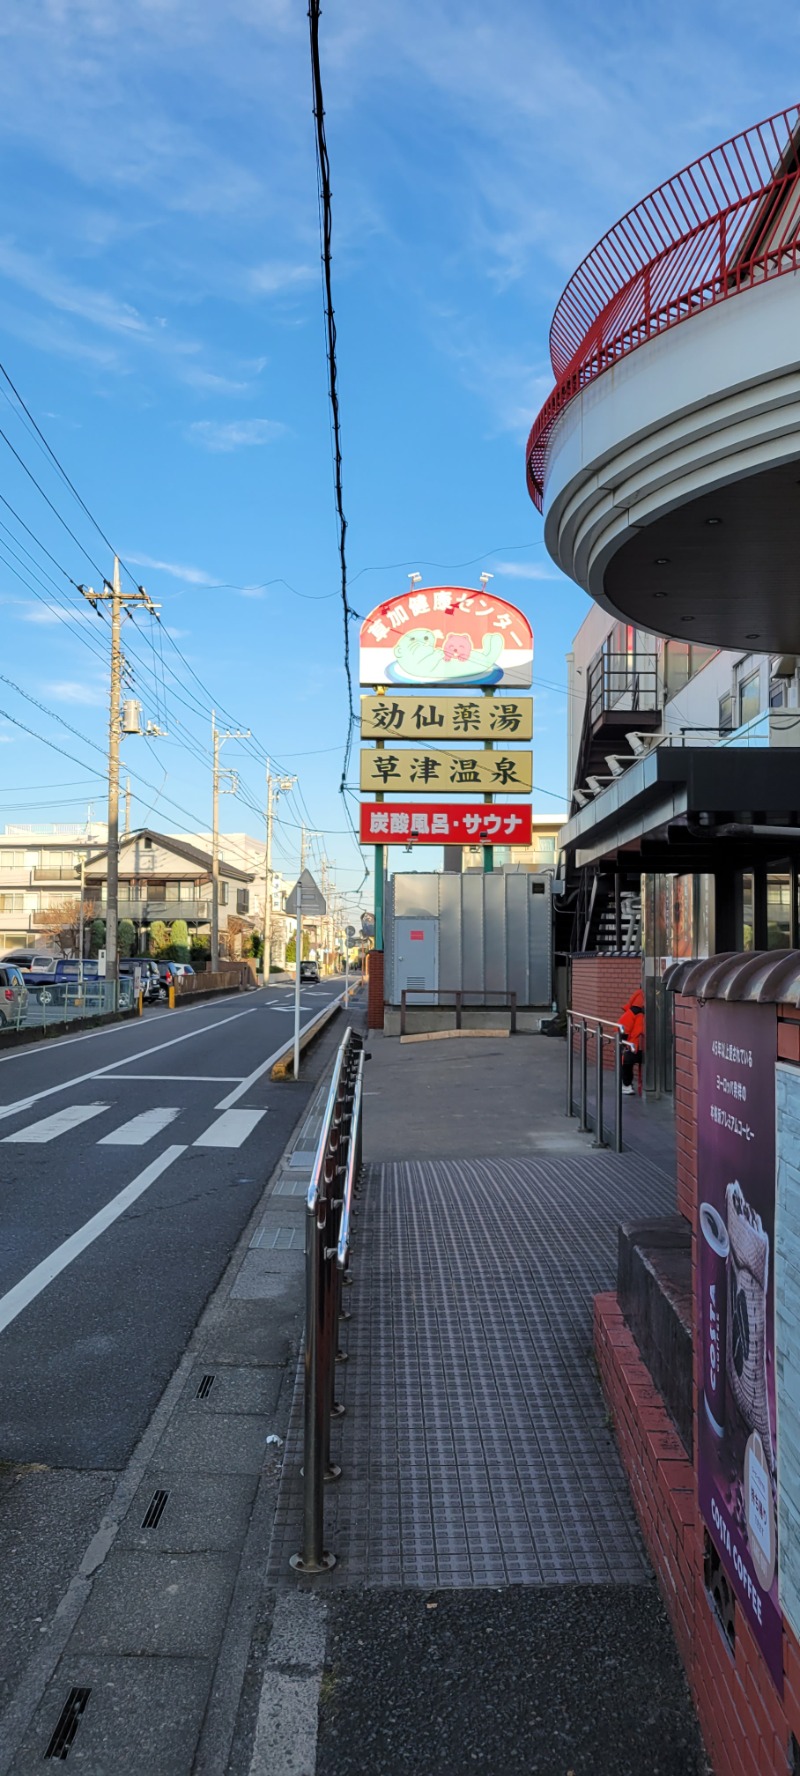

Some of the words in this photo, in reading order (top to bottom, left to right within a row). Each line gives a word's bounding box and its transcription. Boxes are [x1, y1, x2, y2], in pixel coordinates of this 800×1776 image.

[367, 591, 523, 647] 草加健康センター
[372, 702, 522, 733] 効仙薬湯
[371, 755, 520, 785] 草津温泉
[370, 812, 522, 834] 炭酸風呂・サウナ
[711, 1497, 732, 1557] COSTA
[732, 1544, 763, 1626] COFFEE
